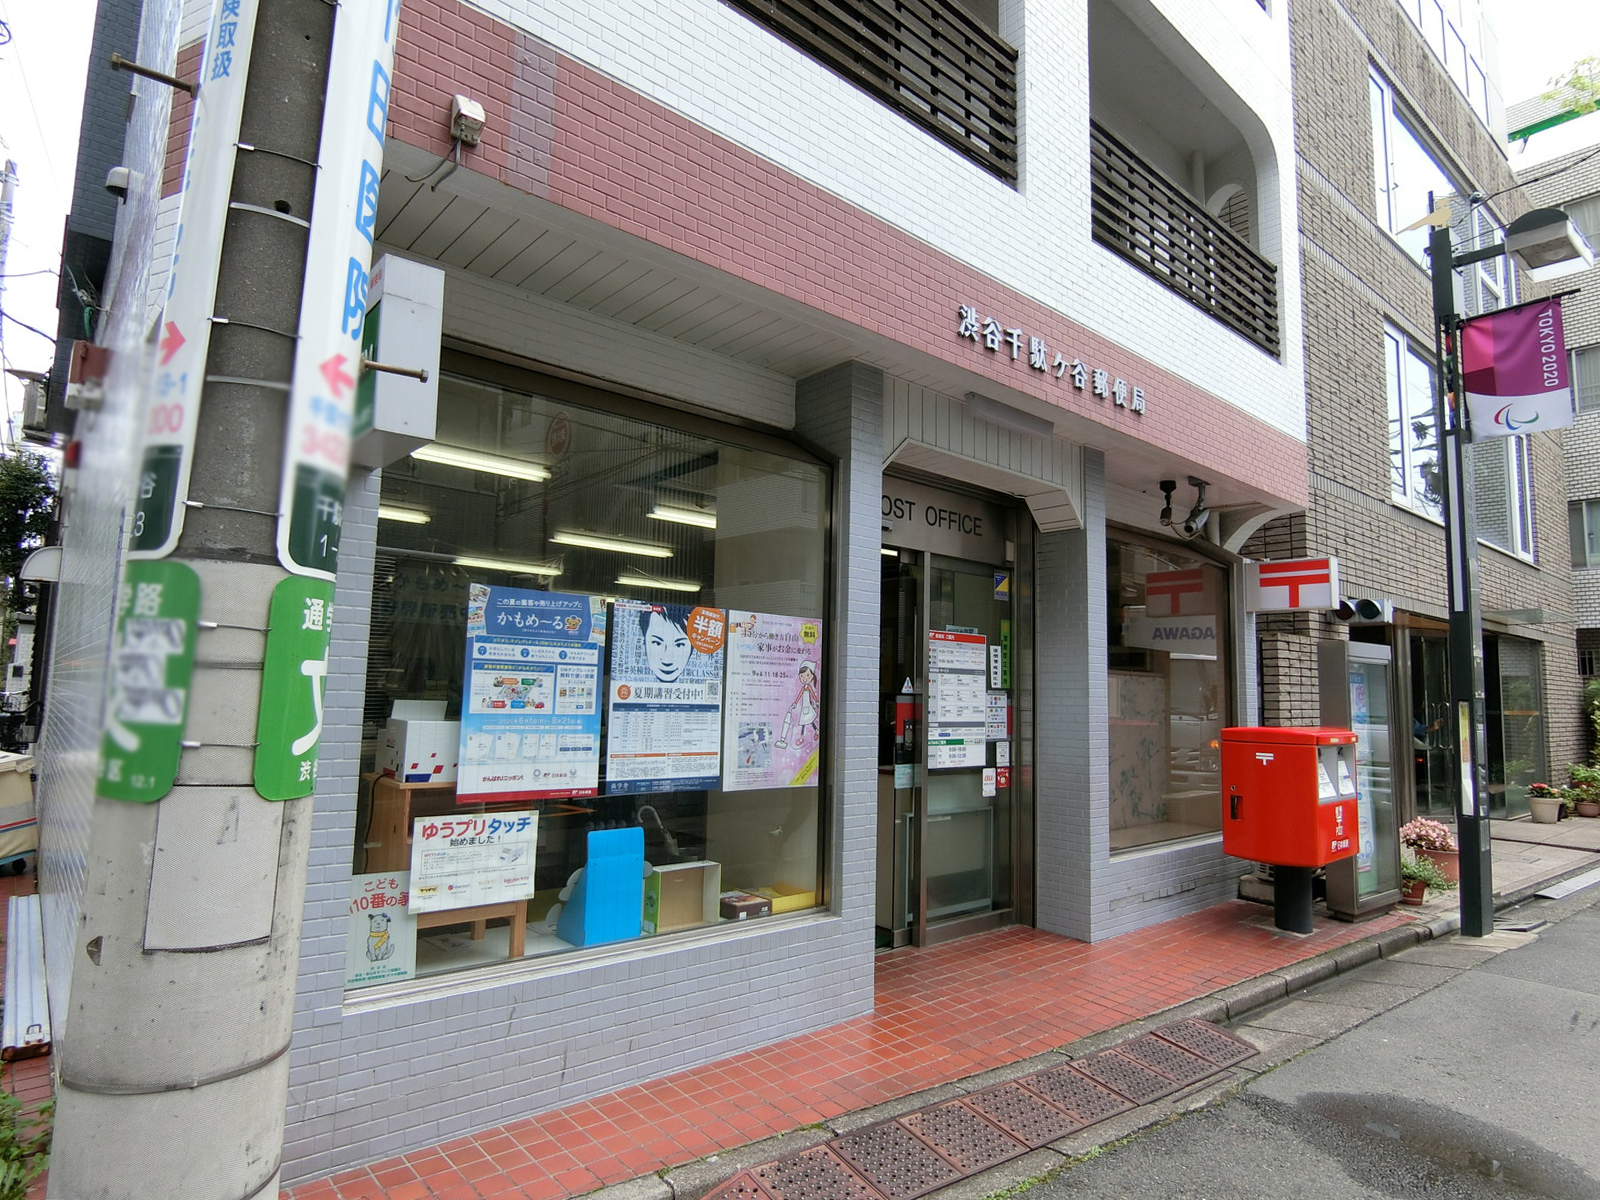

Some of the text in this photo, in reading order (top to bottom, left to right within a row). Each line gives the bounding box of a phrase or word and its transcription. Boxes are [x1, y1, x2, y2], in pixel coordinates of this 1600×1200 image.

[958, 304, 1146, 415] 渋谷千駄ケ谷郵便局
[1538, 309, 1559, 387] TOKYO 2020
[882, 494, 983, 537] OST OFFICE
[692, 615, 724, 639] 半額
[422, 816, 531, 840] ゆうプリタッチ
[364, 878, 399, 894] こども
